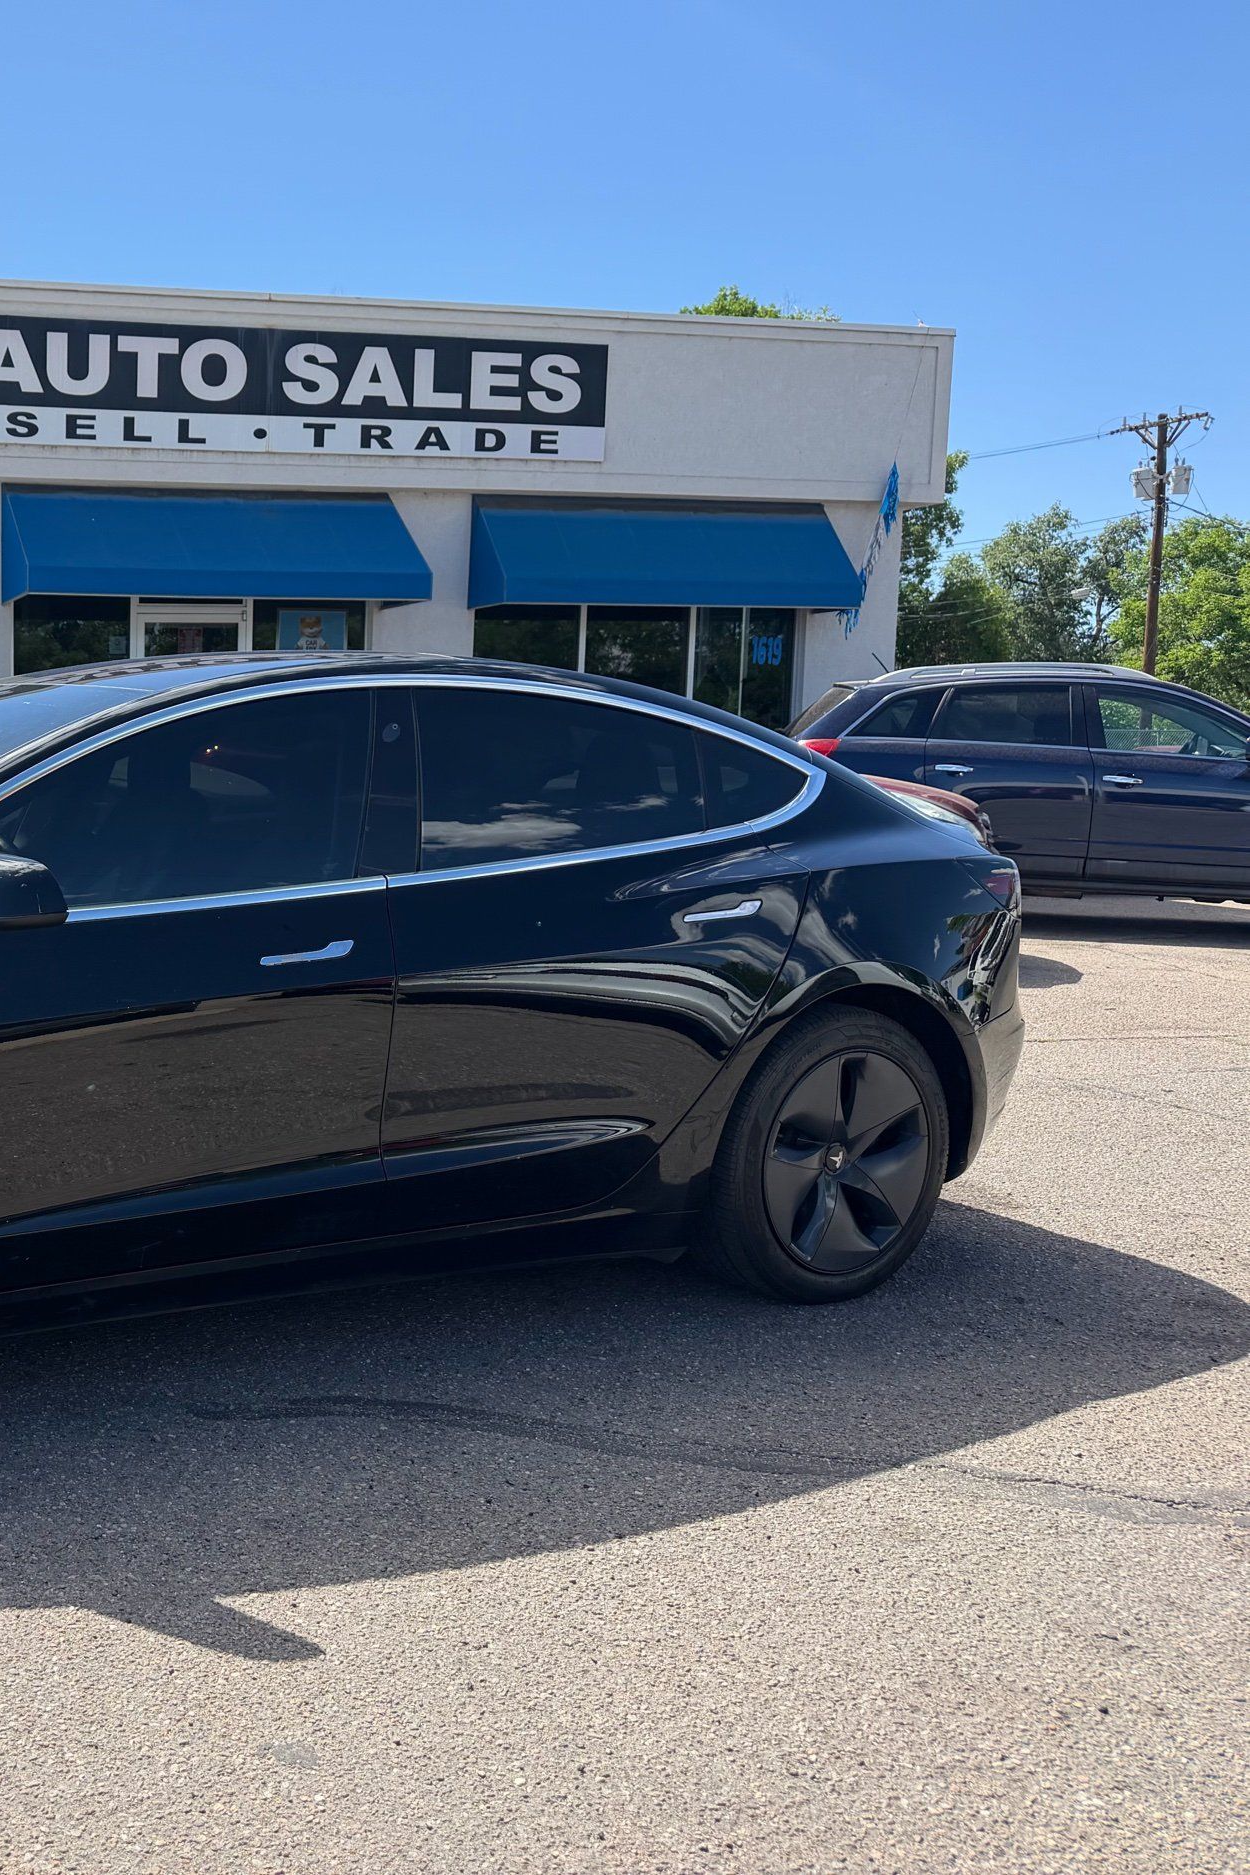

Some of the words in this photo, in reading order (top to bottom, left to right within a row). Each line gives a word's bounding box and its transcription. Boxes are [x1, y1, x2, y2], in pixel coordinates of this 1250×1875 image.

[282, 343, 582, 414] SALES
[5, 411, 207, 445] SELL
[302, 422, 559, 455] TRADE
[751, 635, 782, 666] 1619
